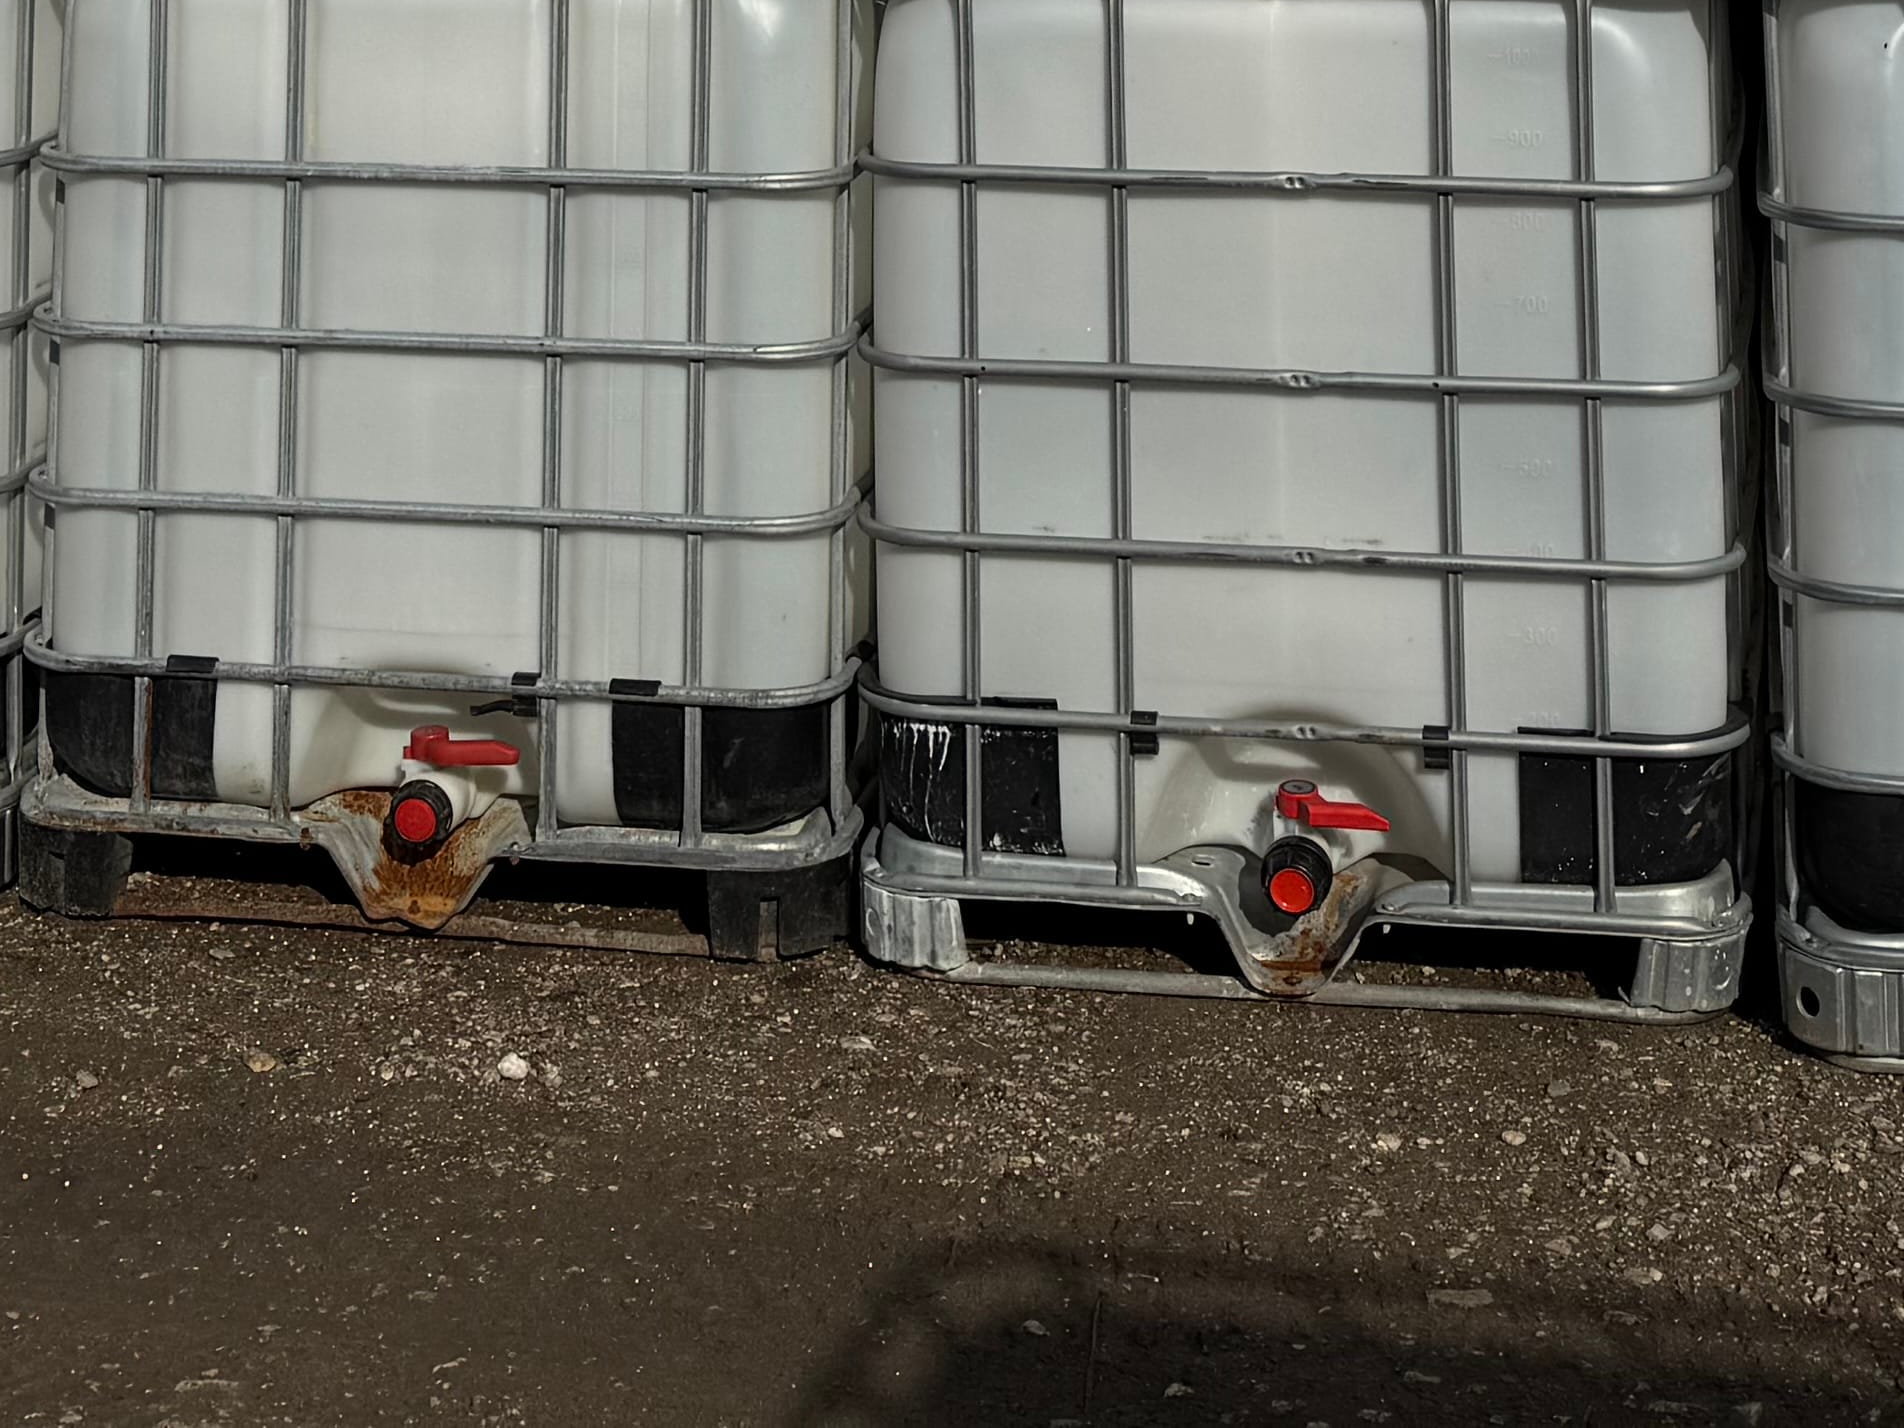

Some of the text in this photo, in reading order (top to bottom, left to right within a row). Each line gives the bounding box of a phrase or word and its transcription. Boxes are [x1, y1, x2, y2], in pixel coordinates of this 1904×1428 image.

[1507, 129, 1544, 147] 900
[1515, 295, 1548, 313] 700
[1525, 625, 1558, 647] 300
